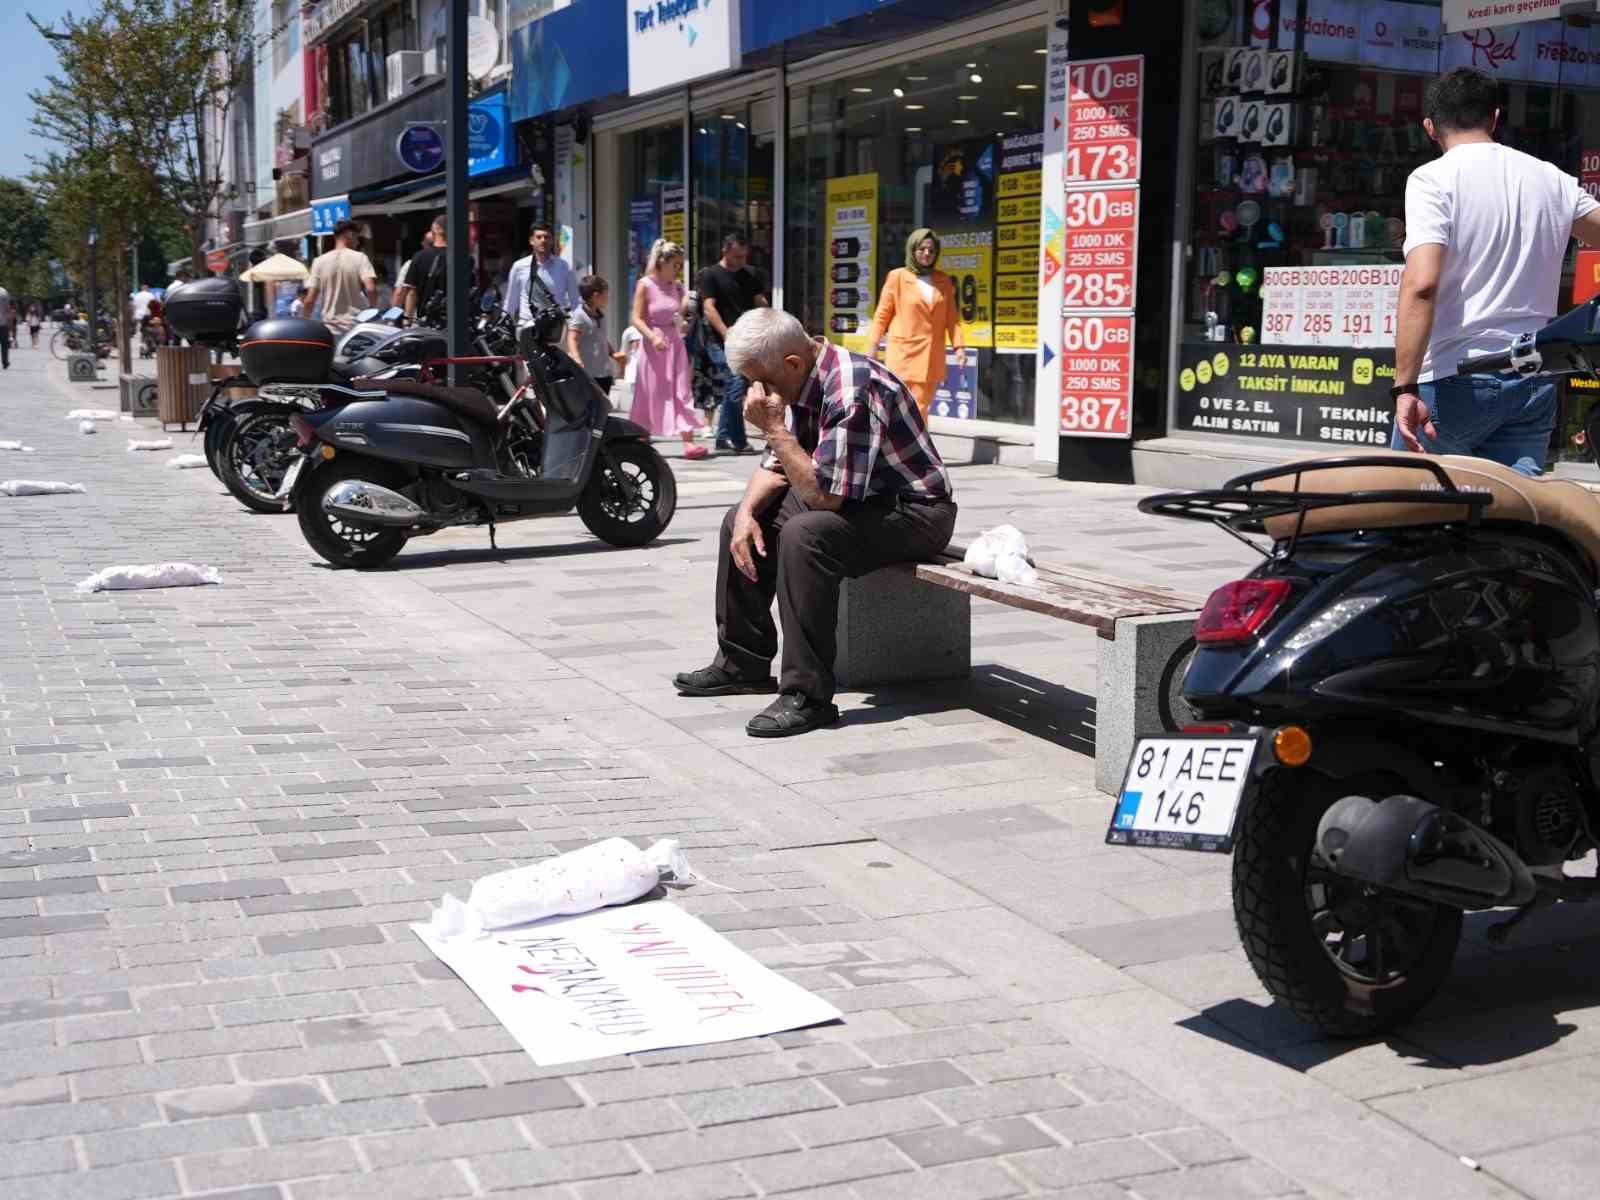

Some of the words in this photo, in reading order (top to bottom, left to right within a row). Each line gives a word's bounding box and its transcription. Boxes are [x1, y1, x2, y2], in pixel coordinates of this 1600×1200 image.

[1467, 6, 1491, 19] Kredi
[1282, 16, 1356, 40] vodafone
[1462, 27, 1521, 69] Red
[1075, 106, 1106, 122] 1000
[1108, 104, 1130, 119] DK
[1073, 126, 1097, 141] 250
[1099, 123, 1130, 138] SMS
[1072, 234, 1102, 248] 1000
[1103, 233, 1125, 246] DK
[1070, 253, 1092, 267] 250
[1095, 251, 1126, 266] SMS
[1264, 271, 1300, 286] 60GB
[1302, 270, 1340, 285] 30GB
[1342, 269, 1381, 285] 20GB
[1265, 314, 1294, 332] 387
[1303, 314, 1333, 333] 285
[1343, 314, 1373, 333] 191
[1069, 358, 1098, 372] 1000
[1101, 358, 1121, 372] DK
[1239, 353, 1256, 368] 12
[1258, 353, 1286, 369] AYA
[1289, 354, 1340, 371] VARAN
[1065, 377, 1088, 391] 250
[1091, 377, 1121, 391] SMS
[1238, 373, 1289, 392] TAKSİT
[1291, 374, 1345, 395] İMKANI
[1213, 398, 1233, 411] VE
[1236, 400, 1250, 412] 2.
[1253, 401, 1274, 414] EL
[1319, 406, 1390, 424] TEKNİK
[1192, 415, 1228, 430] ALIM
[1231, 417, 1280, 433] SATIM
[1319, 427, 1387, 444] SERVİS
[1137, 746, 1170, 778] 81
[1175, 747, 1244, 781] AEE
[1153, 789, 1205, 825] 146
[513, 936, 654, 1036] NETANYAHU
